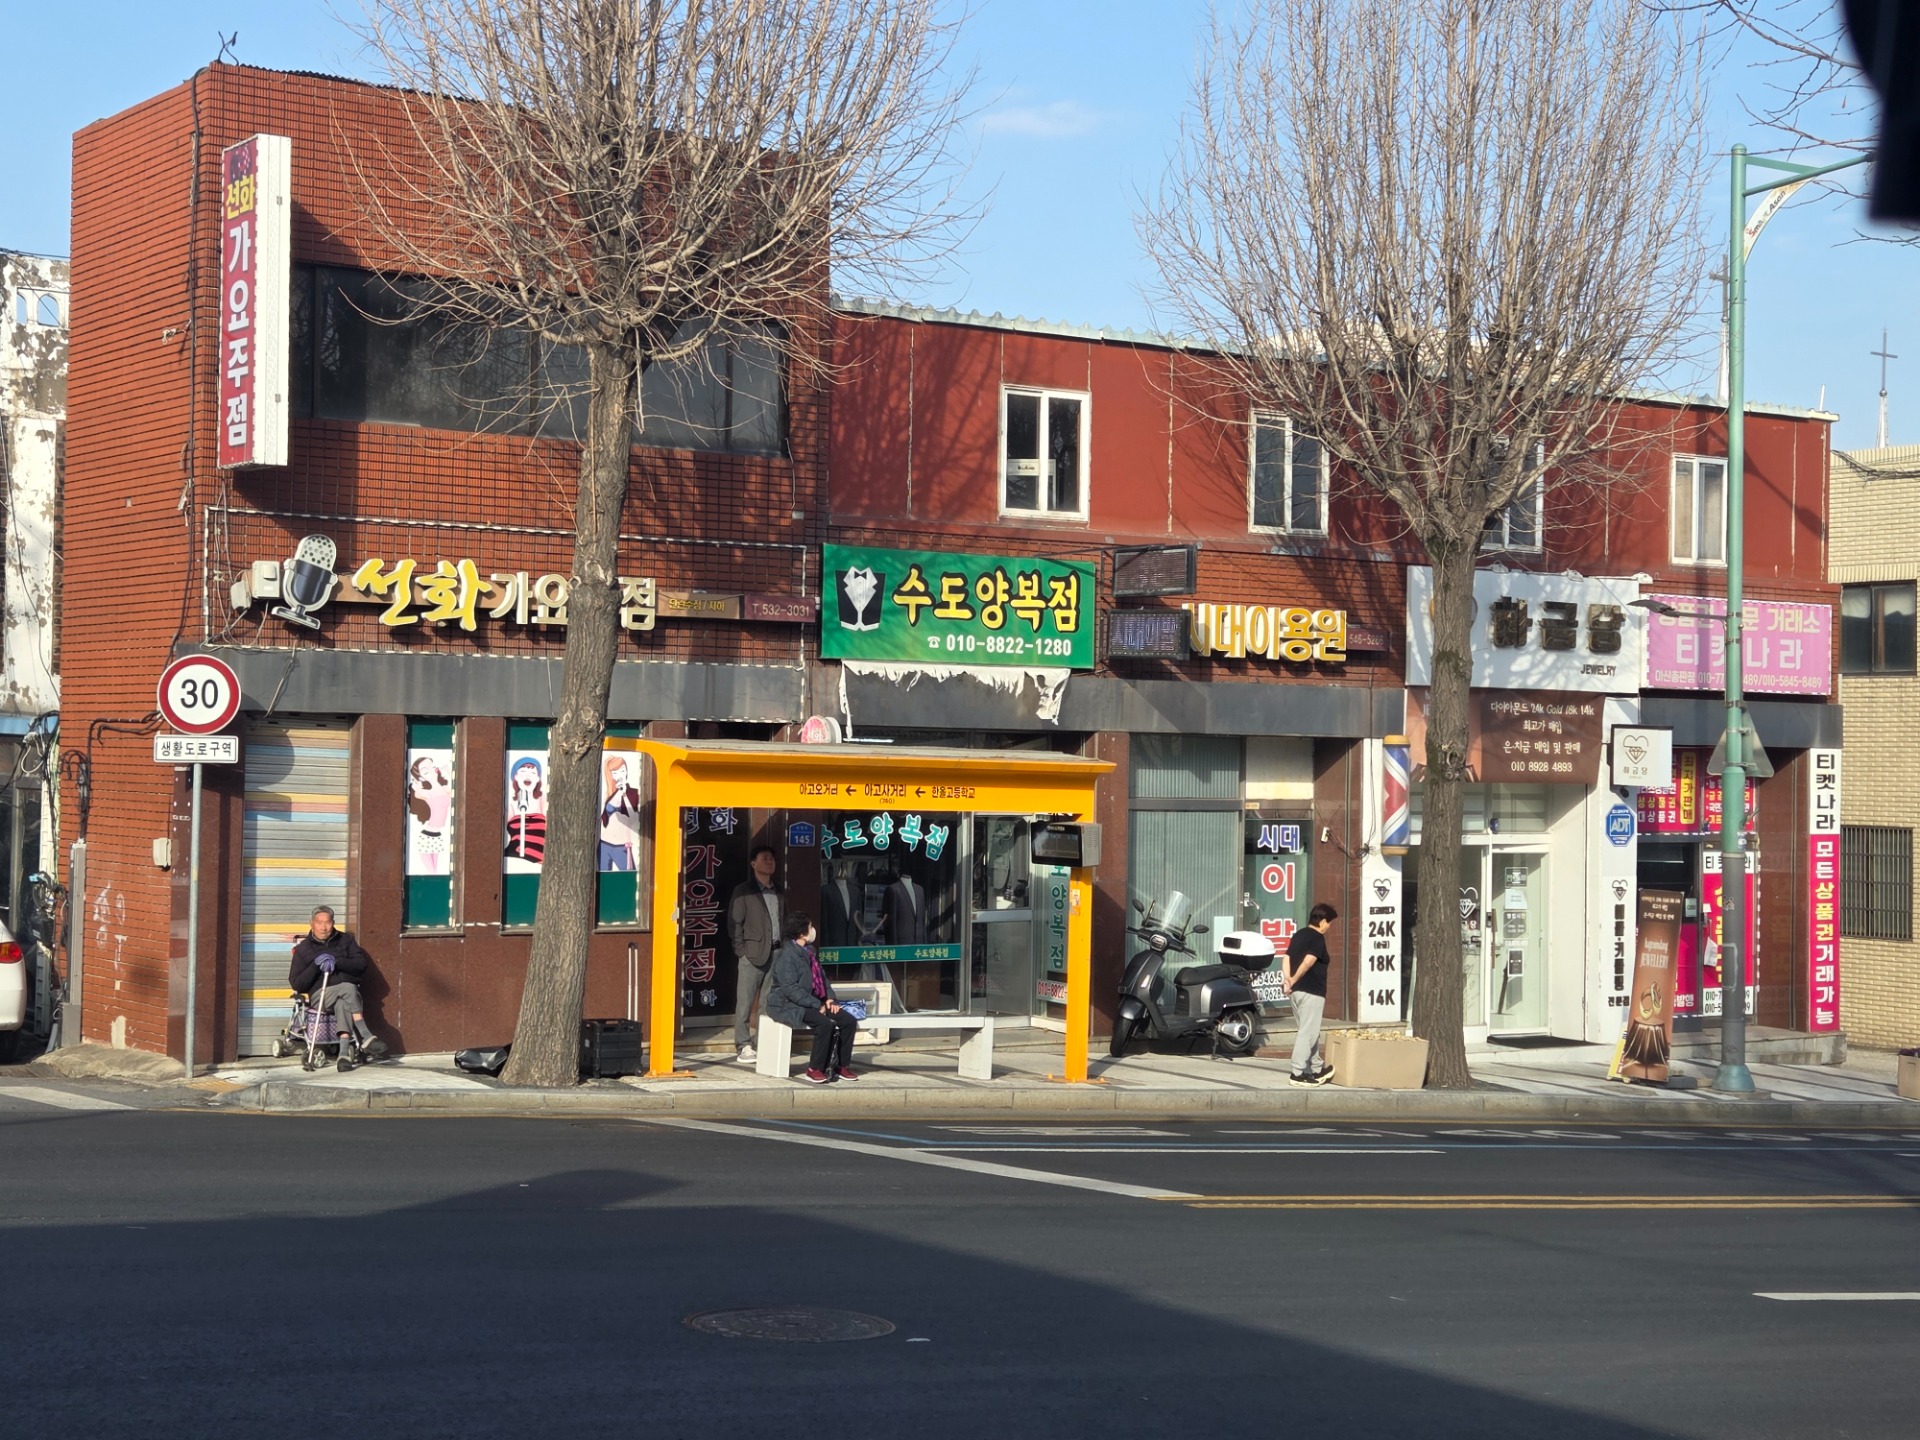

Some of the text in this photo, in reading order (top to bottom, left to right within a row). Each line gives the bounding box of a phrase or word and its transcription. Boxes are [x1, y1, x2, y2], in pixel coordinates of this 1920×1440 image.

[226, 173, 255, 219] 선화
[1769, 190, 1786, 213] Asan
[226, 220, 252, 447] 가요주점
[351, 558, 656, 632] 선화 가요점
[892, 563, 1080, 633] 수도양복점
[752, 603, 810, 617] T.532-3031
[1767, 608, 1821, 634] 거래소
[946, 633, 1072, 656] 010-8822-1280
[1580, 663, 1617, 677] JEWELRY
[180, 678, 219, 709] 30
[1490, 702, 1530, 716] 다이아몬드
[1580, 704, 1595, 716] 14k
[1522, 719, 1546, 732] 최고가
[160, 741, 232, 757] 생활도로구역
[1534, 741, 1550, 754] 매입
[1553, 741, 1561, 755] 및
[1564, 742, 1581, 755] 판매
[1510, 761, 1573, 773] 010 8928 4893
[1815, 753, 1836, 831] 티켓나라
[1610, 818, 1630, 833] ADT
[794, 835, 811, 845] 145
[821, 811, 950, 862] 수도양복점
[1257, 825, 1300, 853] 시대
[686, 844, 723, 983] 가요주점
[1368, 920, 1396, 938] 24K
[860, 949, 896, 960] 수도양복점
[914, 947, 949, 958] 수도양복점
[1368, 954, 1396, 972] 18K
[1368, 989, 1396, 1006] 14K
